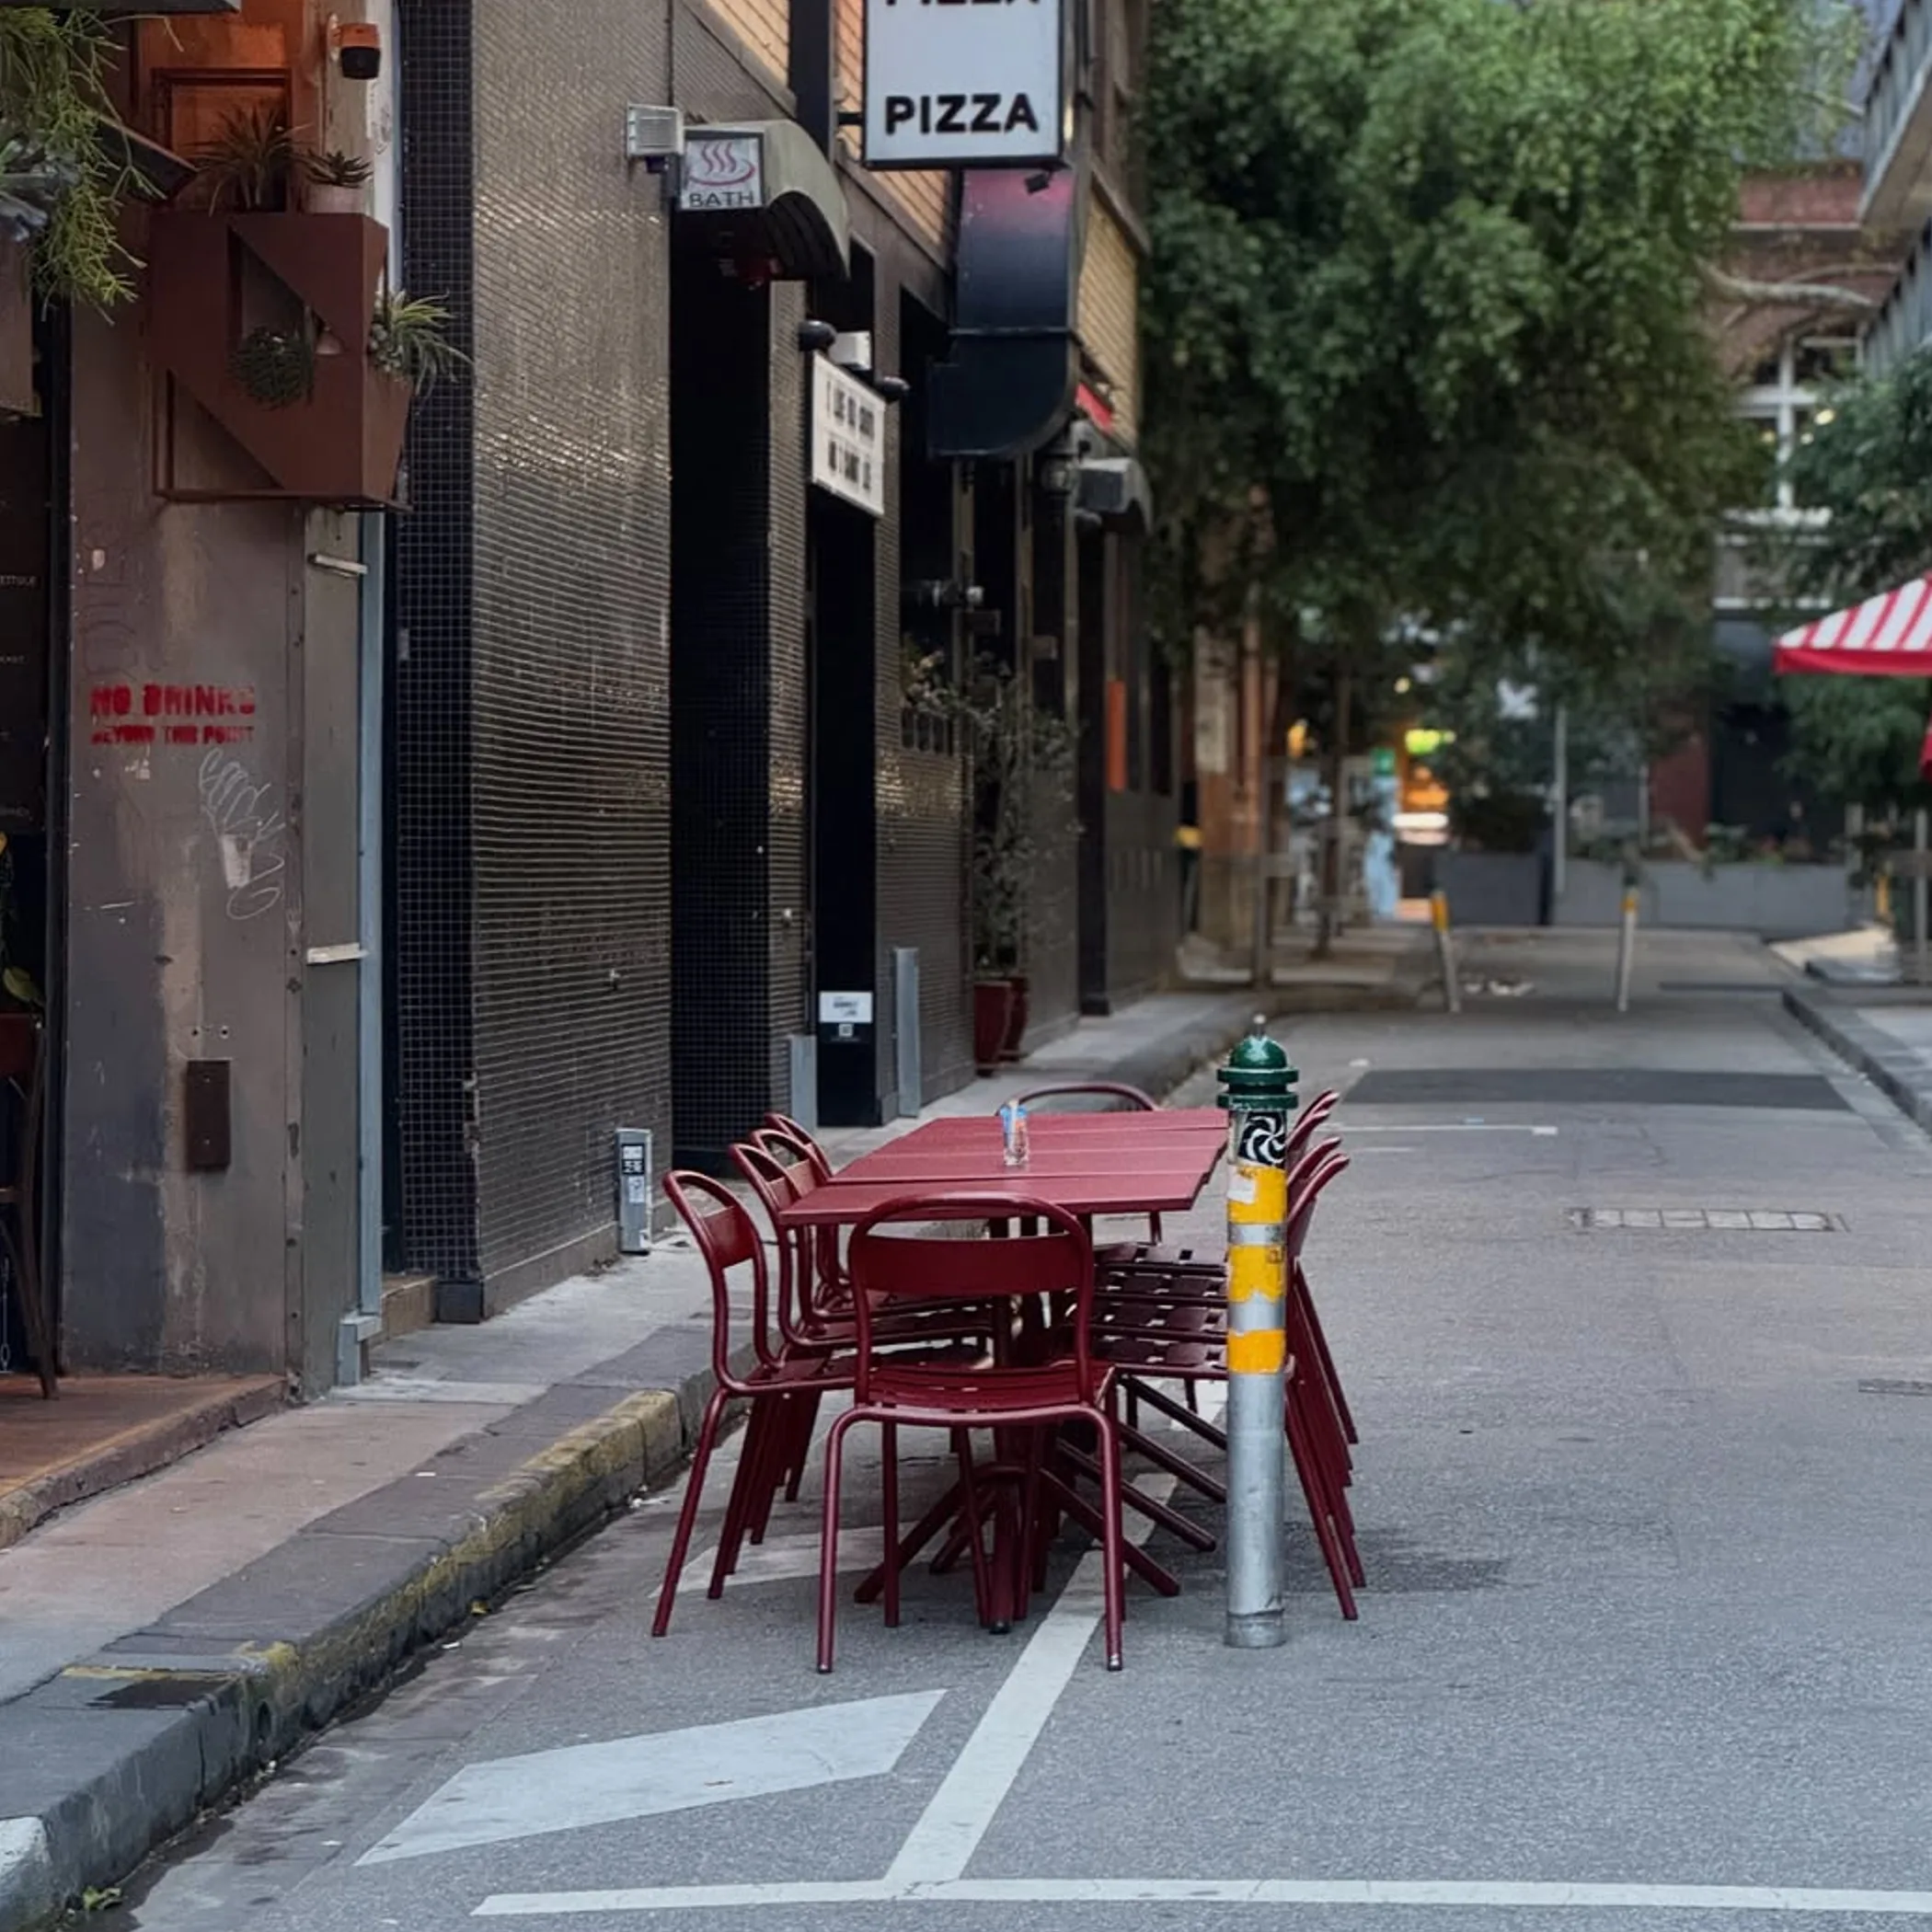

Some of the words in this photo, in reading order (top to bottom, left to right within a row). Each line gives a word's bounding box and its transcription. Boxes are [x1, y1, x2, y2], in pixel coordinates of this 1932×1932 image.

[885, 93, 1039, 134] PIZZA
[688, 190, 754, 208] BATH
[90, 684, 131, 716] NO
